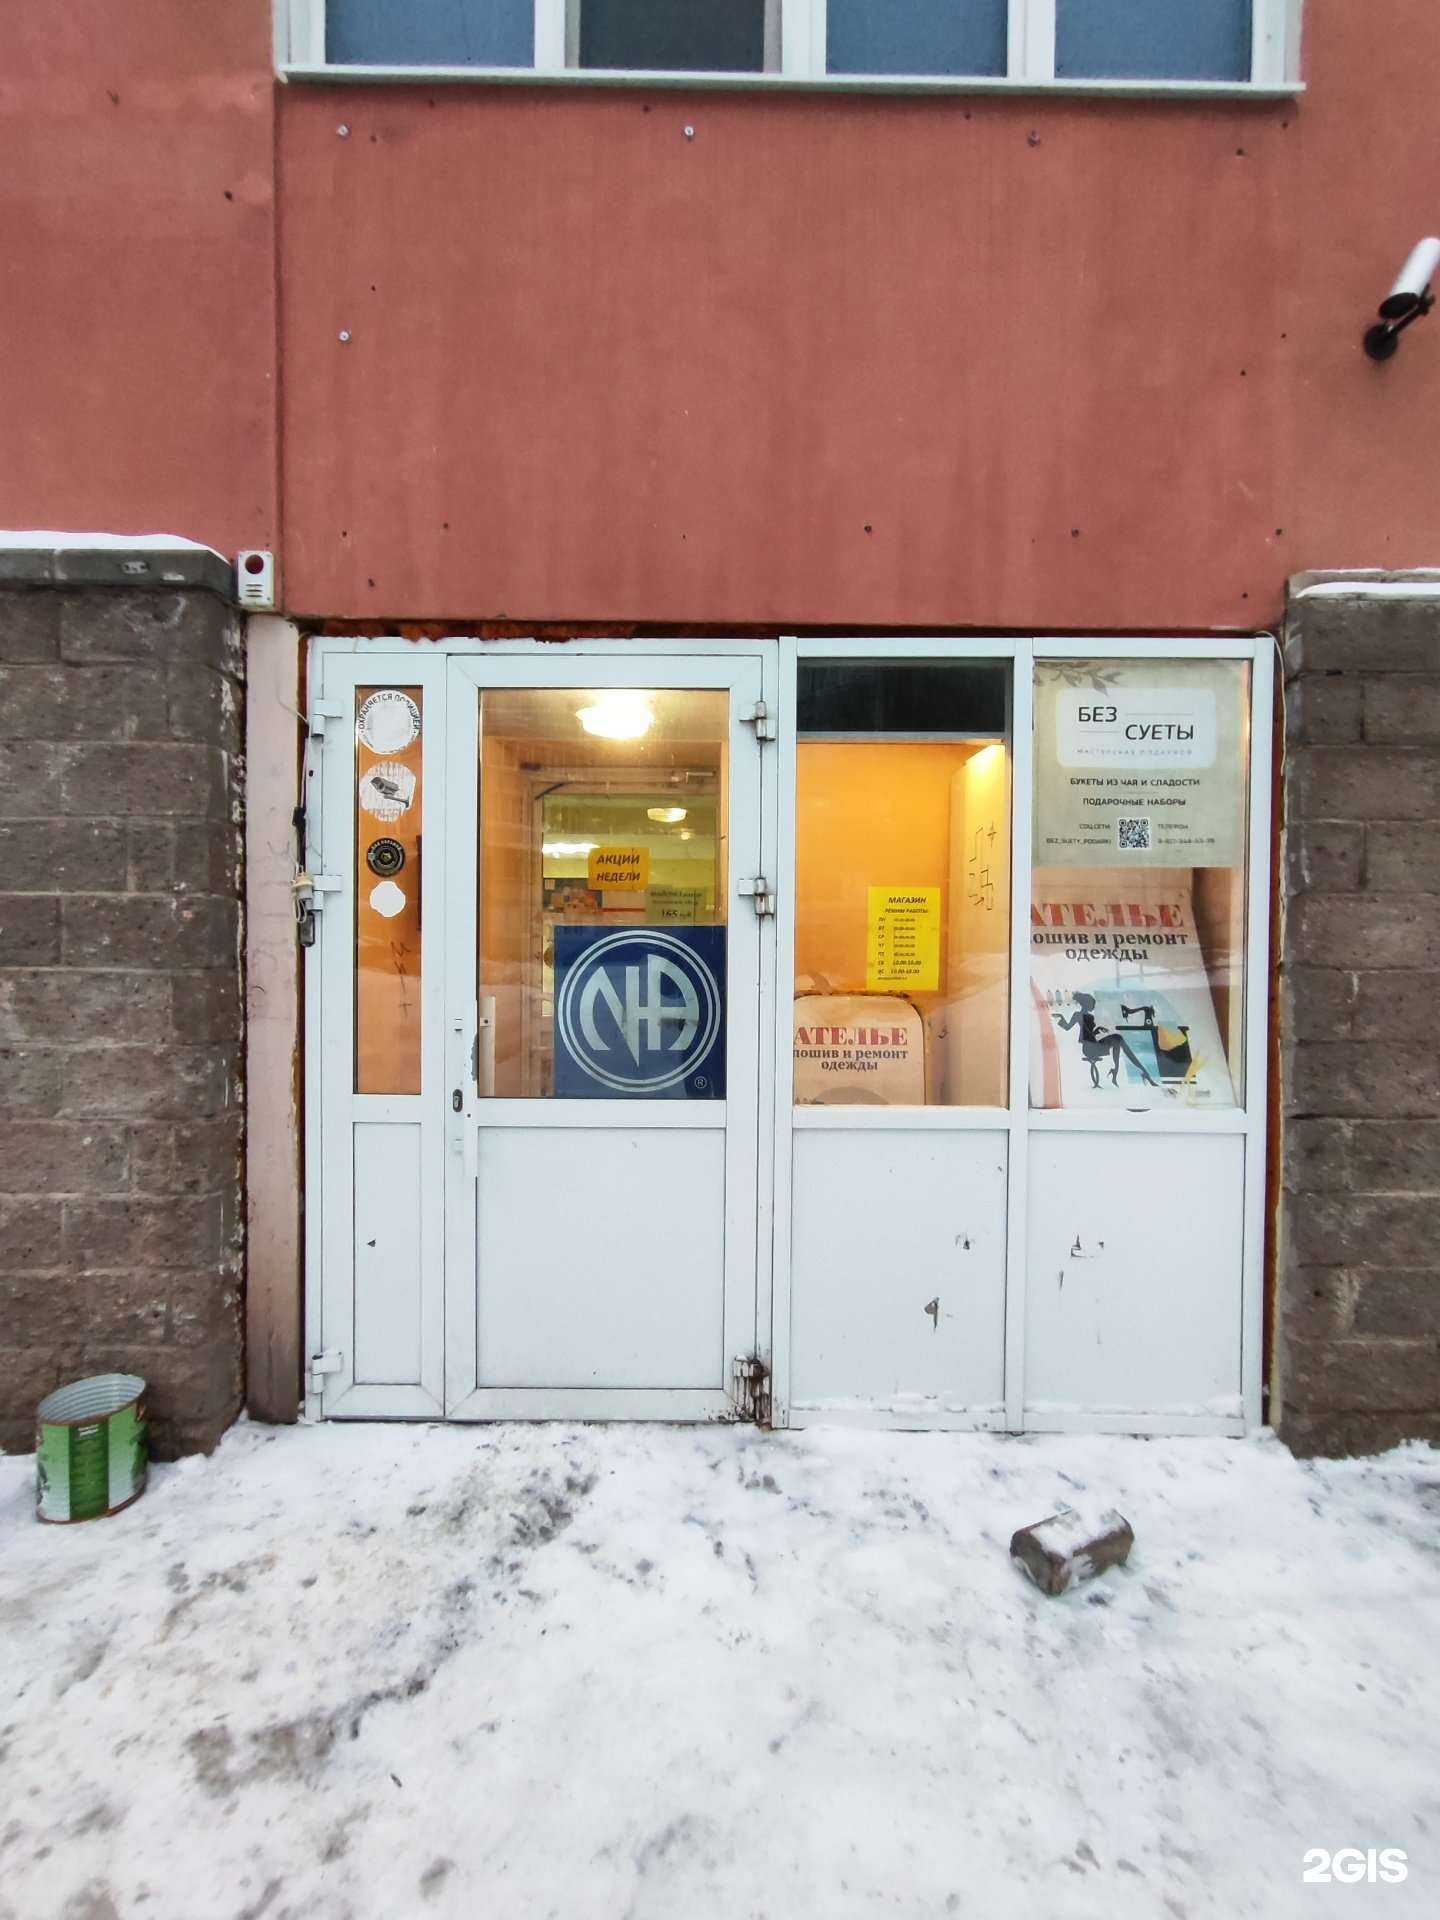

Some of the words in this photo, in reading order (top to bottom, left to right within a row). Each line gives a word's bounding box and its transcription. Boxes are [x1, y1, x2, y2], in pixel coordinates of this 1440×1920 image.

[1078, 706, 1118, 722] БЕЗ
[1125, 724, 1194, 740] СУЕТЫ
[1070, 777, 1104, 786] БУКЕТЫ
[1106, 778, 1119, 786] ИЗ
[1122, 778, 1138, 786] ЧАЯ
[1141, 778, 1148, 786] И
[1150, 778, 1200, 787] СЛАДОСТИ
[1083, 798, 1144, 806] ПОДАРОЧНЫЕ
[1147, 798, 1187, 806] НАБОРЫ
[596, 854, 640, 866] АКЦИИ
[596, 872, 641, 883] НЕДЕЛИ
[888, 896, 927, 904] МАГАЗИН
[1031, 903, 1184, 928] АТЕЛЬЕ
[1031, 932, 1089, 945] ошив
[1095, 932, 1107, 945] и
[1113, 932, 1189, 949] ремонт
[1065, 947, 1150, 962] одежды
[794, 1026, 908, 1046] АТЕЛЬЕ
[843, 1050, 852, 1058] и
[856, 1050, 908, 1061] ремонт
[821, 1061, 878, 1072] одежды
